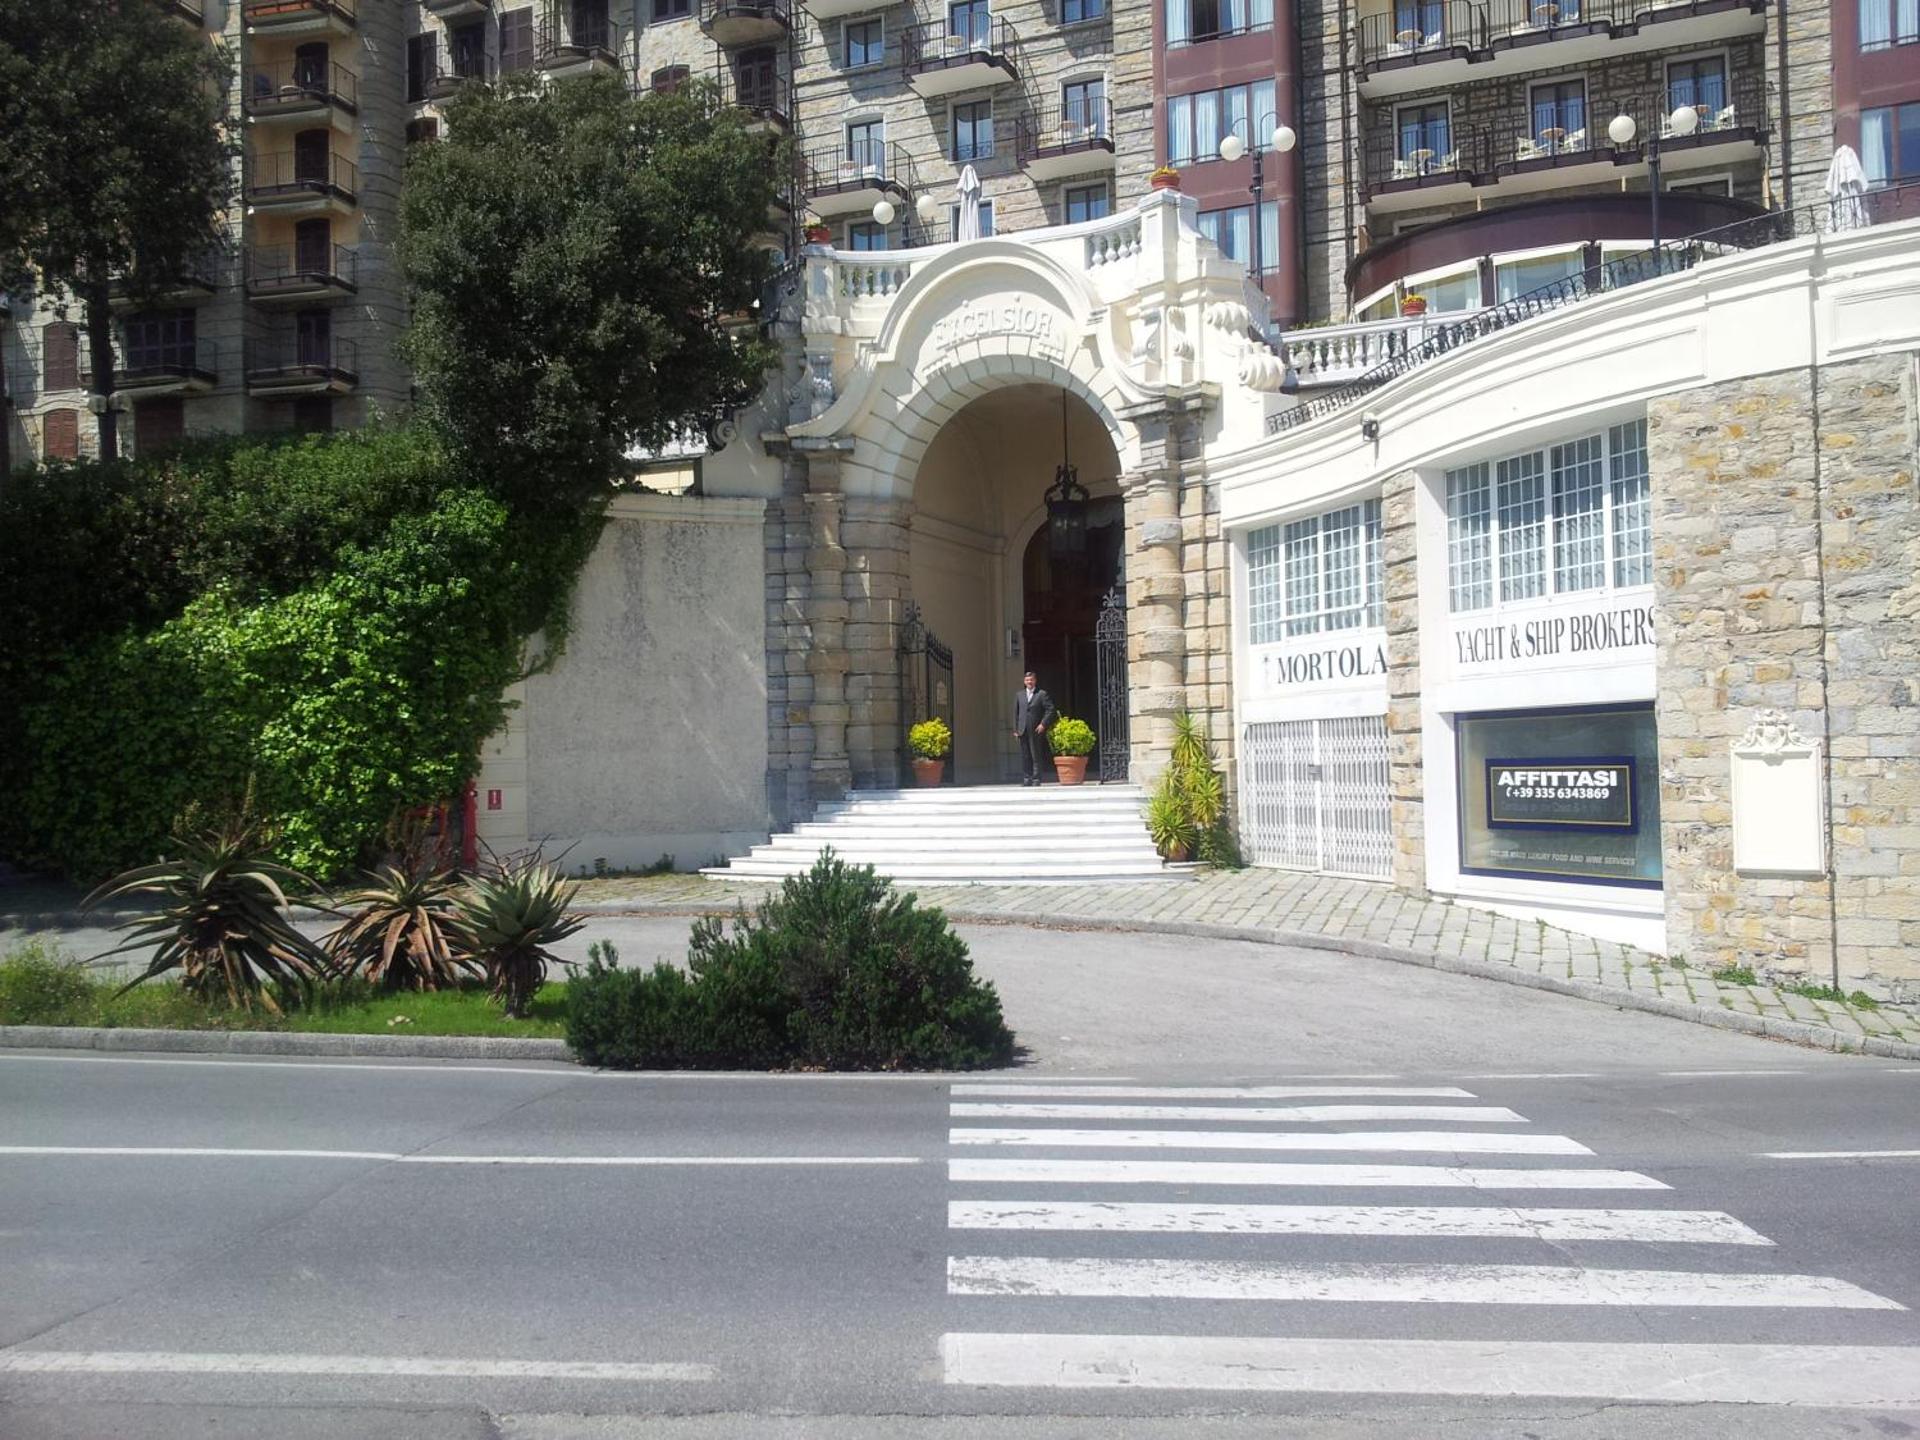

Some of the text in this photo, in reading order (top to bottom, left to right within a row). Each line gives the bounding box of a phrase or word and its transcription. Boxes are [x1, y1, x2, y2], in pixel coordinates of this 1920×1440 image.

[1455, 626, 1505, 664] YACHT
[1510, 624, 1521, 660] &
[1525, 618, 1565, 658] SHIP
[1277, 643, 1388, 684] MORTOLA
[1498, 770, 1618, 787] AFFITTASI
[1512, 787, 1610, 799] +39 335 6343869
[1569, 854, 1584, 863] AND
